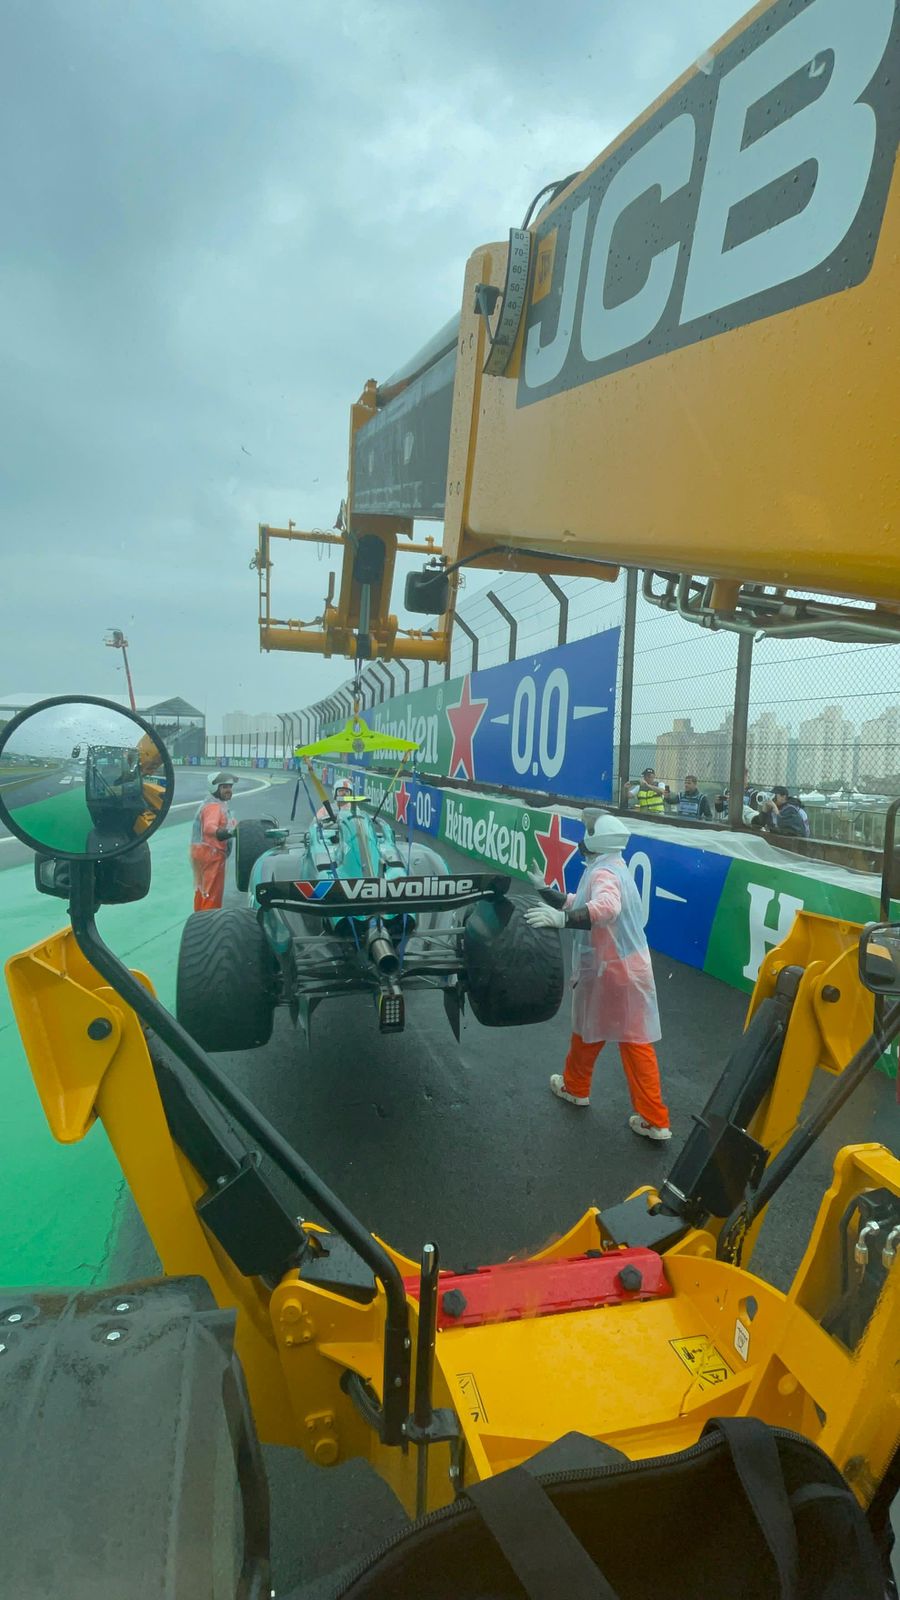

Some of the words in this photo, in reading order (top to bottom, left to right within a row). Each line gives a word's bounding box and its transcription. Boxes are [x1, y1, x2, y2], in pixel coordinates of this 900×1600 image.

[525, 0, 896, 389] JCB
[514, 231, 525, 240] 80
[514, 248, 524, 256] 70
[512, 265, 522, 274] 60
[510, 283, 520, 292] 50
[507, 301, 517, 310] 40
[445, 798, 528, 872] Heineken
[340, 876, 475, 900] Valvoline
